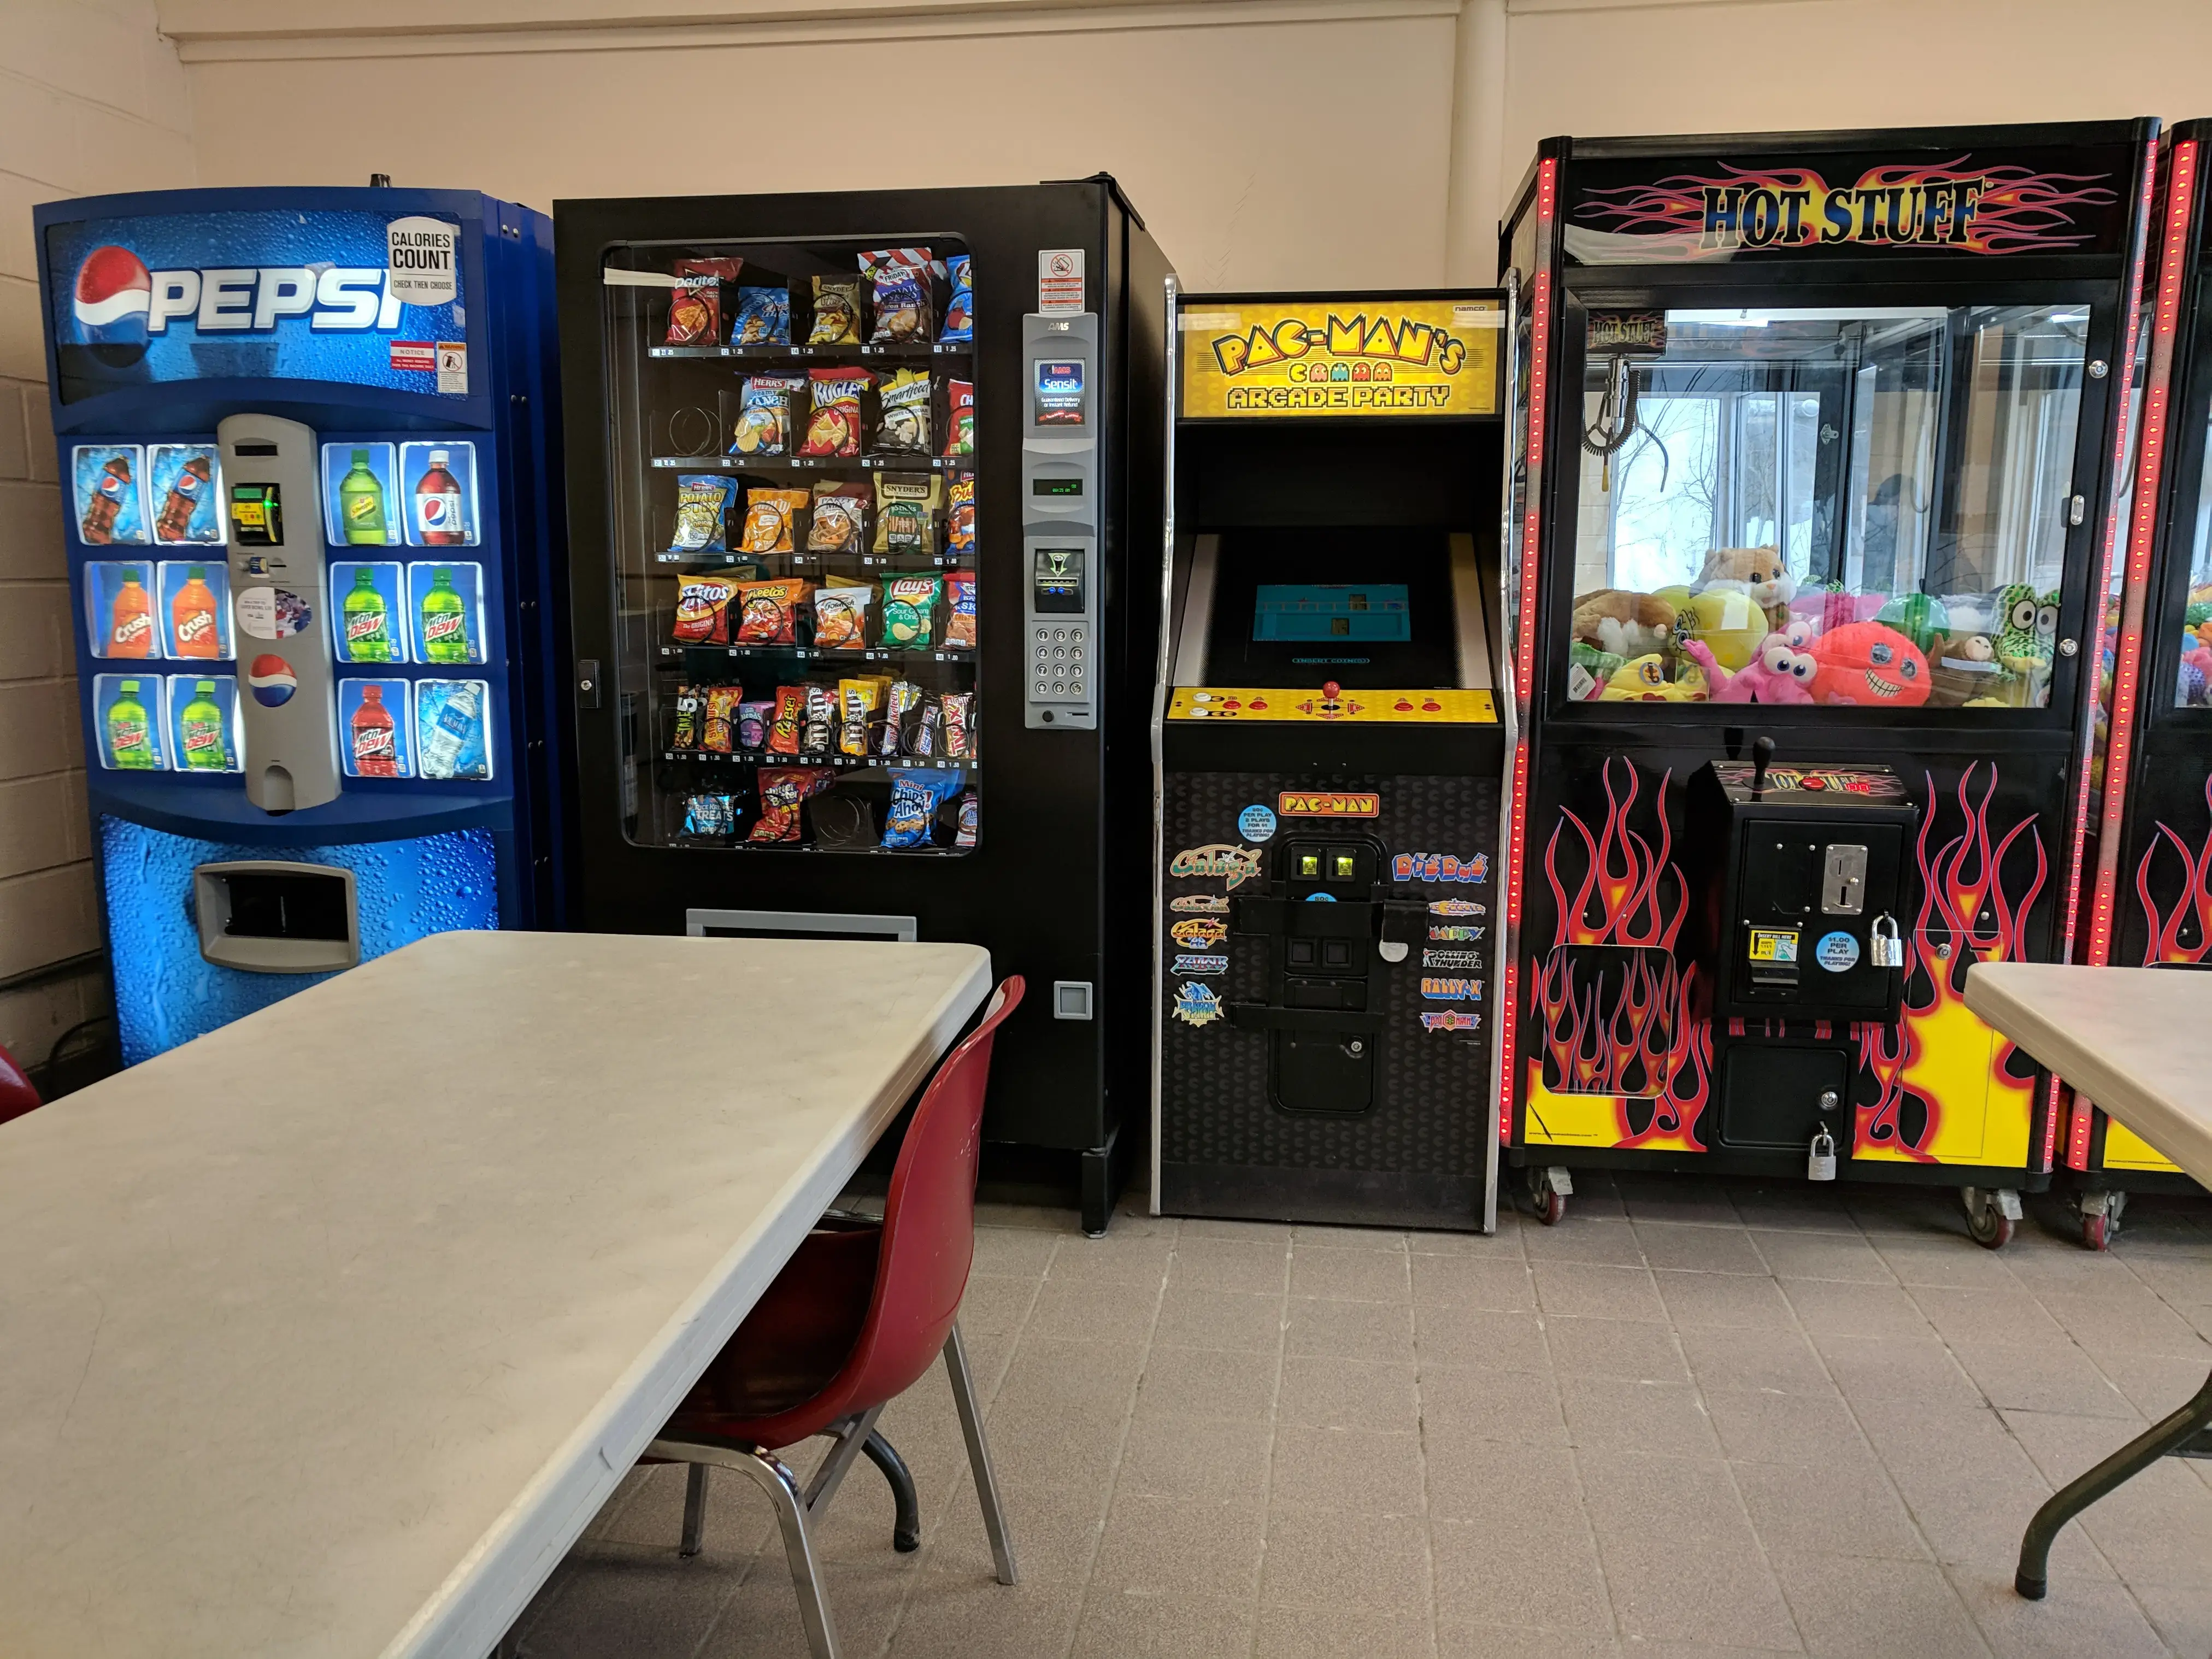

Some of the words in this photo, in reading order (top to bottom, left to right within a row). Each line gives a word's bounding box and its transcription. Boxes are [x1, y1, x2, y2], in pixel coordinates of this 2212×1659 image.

[1700, 185, 1810, 249] HOT
[1820, 175, 1985, 245] STUFF
[392, 232, 450, 248] CALORIES
[393, 249, 450, 270] COUNT
[393, 280, 412, 289] CHECK
[414, 280, 428, 289] THEN
[430, 281, 452, 290] CHOOSE
[148, 268, 403, 330] PEPSI
[1048, 322, 1069, 331] AMS
[1592, 319, 1618, 344] HOT
[1619, 318, 1657, 344] STUFF
[1211, 312, 1468, 378] PAC-MAN'S
[1044, 378, 1076, 390] Sensit
[881, 382, 931, 409] Smartfood
[1227, 385, 1350, 409] ARCADE
[1351, 385, 1451, 408] PARTY
[833, 405, 858, 415] ORIGINA
[887, 410, 905, 419] WHITE
[679, 492, 722, 503] POTATO
[886, 485, 926, 493] SNYDER'S
[448, 499, 457, 526] pepsi
[679, 501, 721, 514] STIX
[894, 578, 932, 596] Lay's
[115, 613, 151, 644] Crush
[178, 610, 213, 642] Crush
[691, 618, 714, 628] ORIGINA
[677, 711, 693, 733] TAKE
[774, 695, 797, 739] Reese's
[949, 707, 967, 756] TWIX
[898, 779, 925, 791] Mini
[892, 787, 925, 805] Chips
[1284, 796, 1374, 813] PAC-MAN
[696, 810, 734, 822] TREATS
[701, 826, 726, 834] origial
[1171, 919, 1228, 941] Galaga
[1432, 959, 1482, 969] THUNDER
